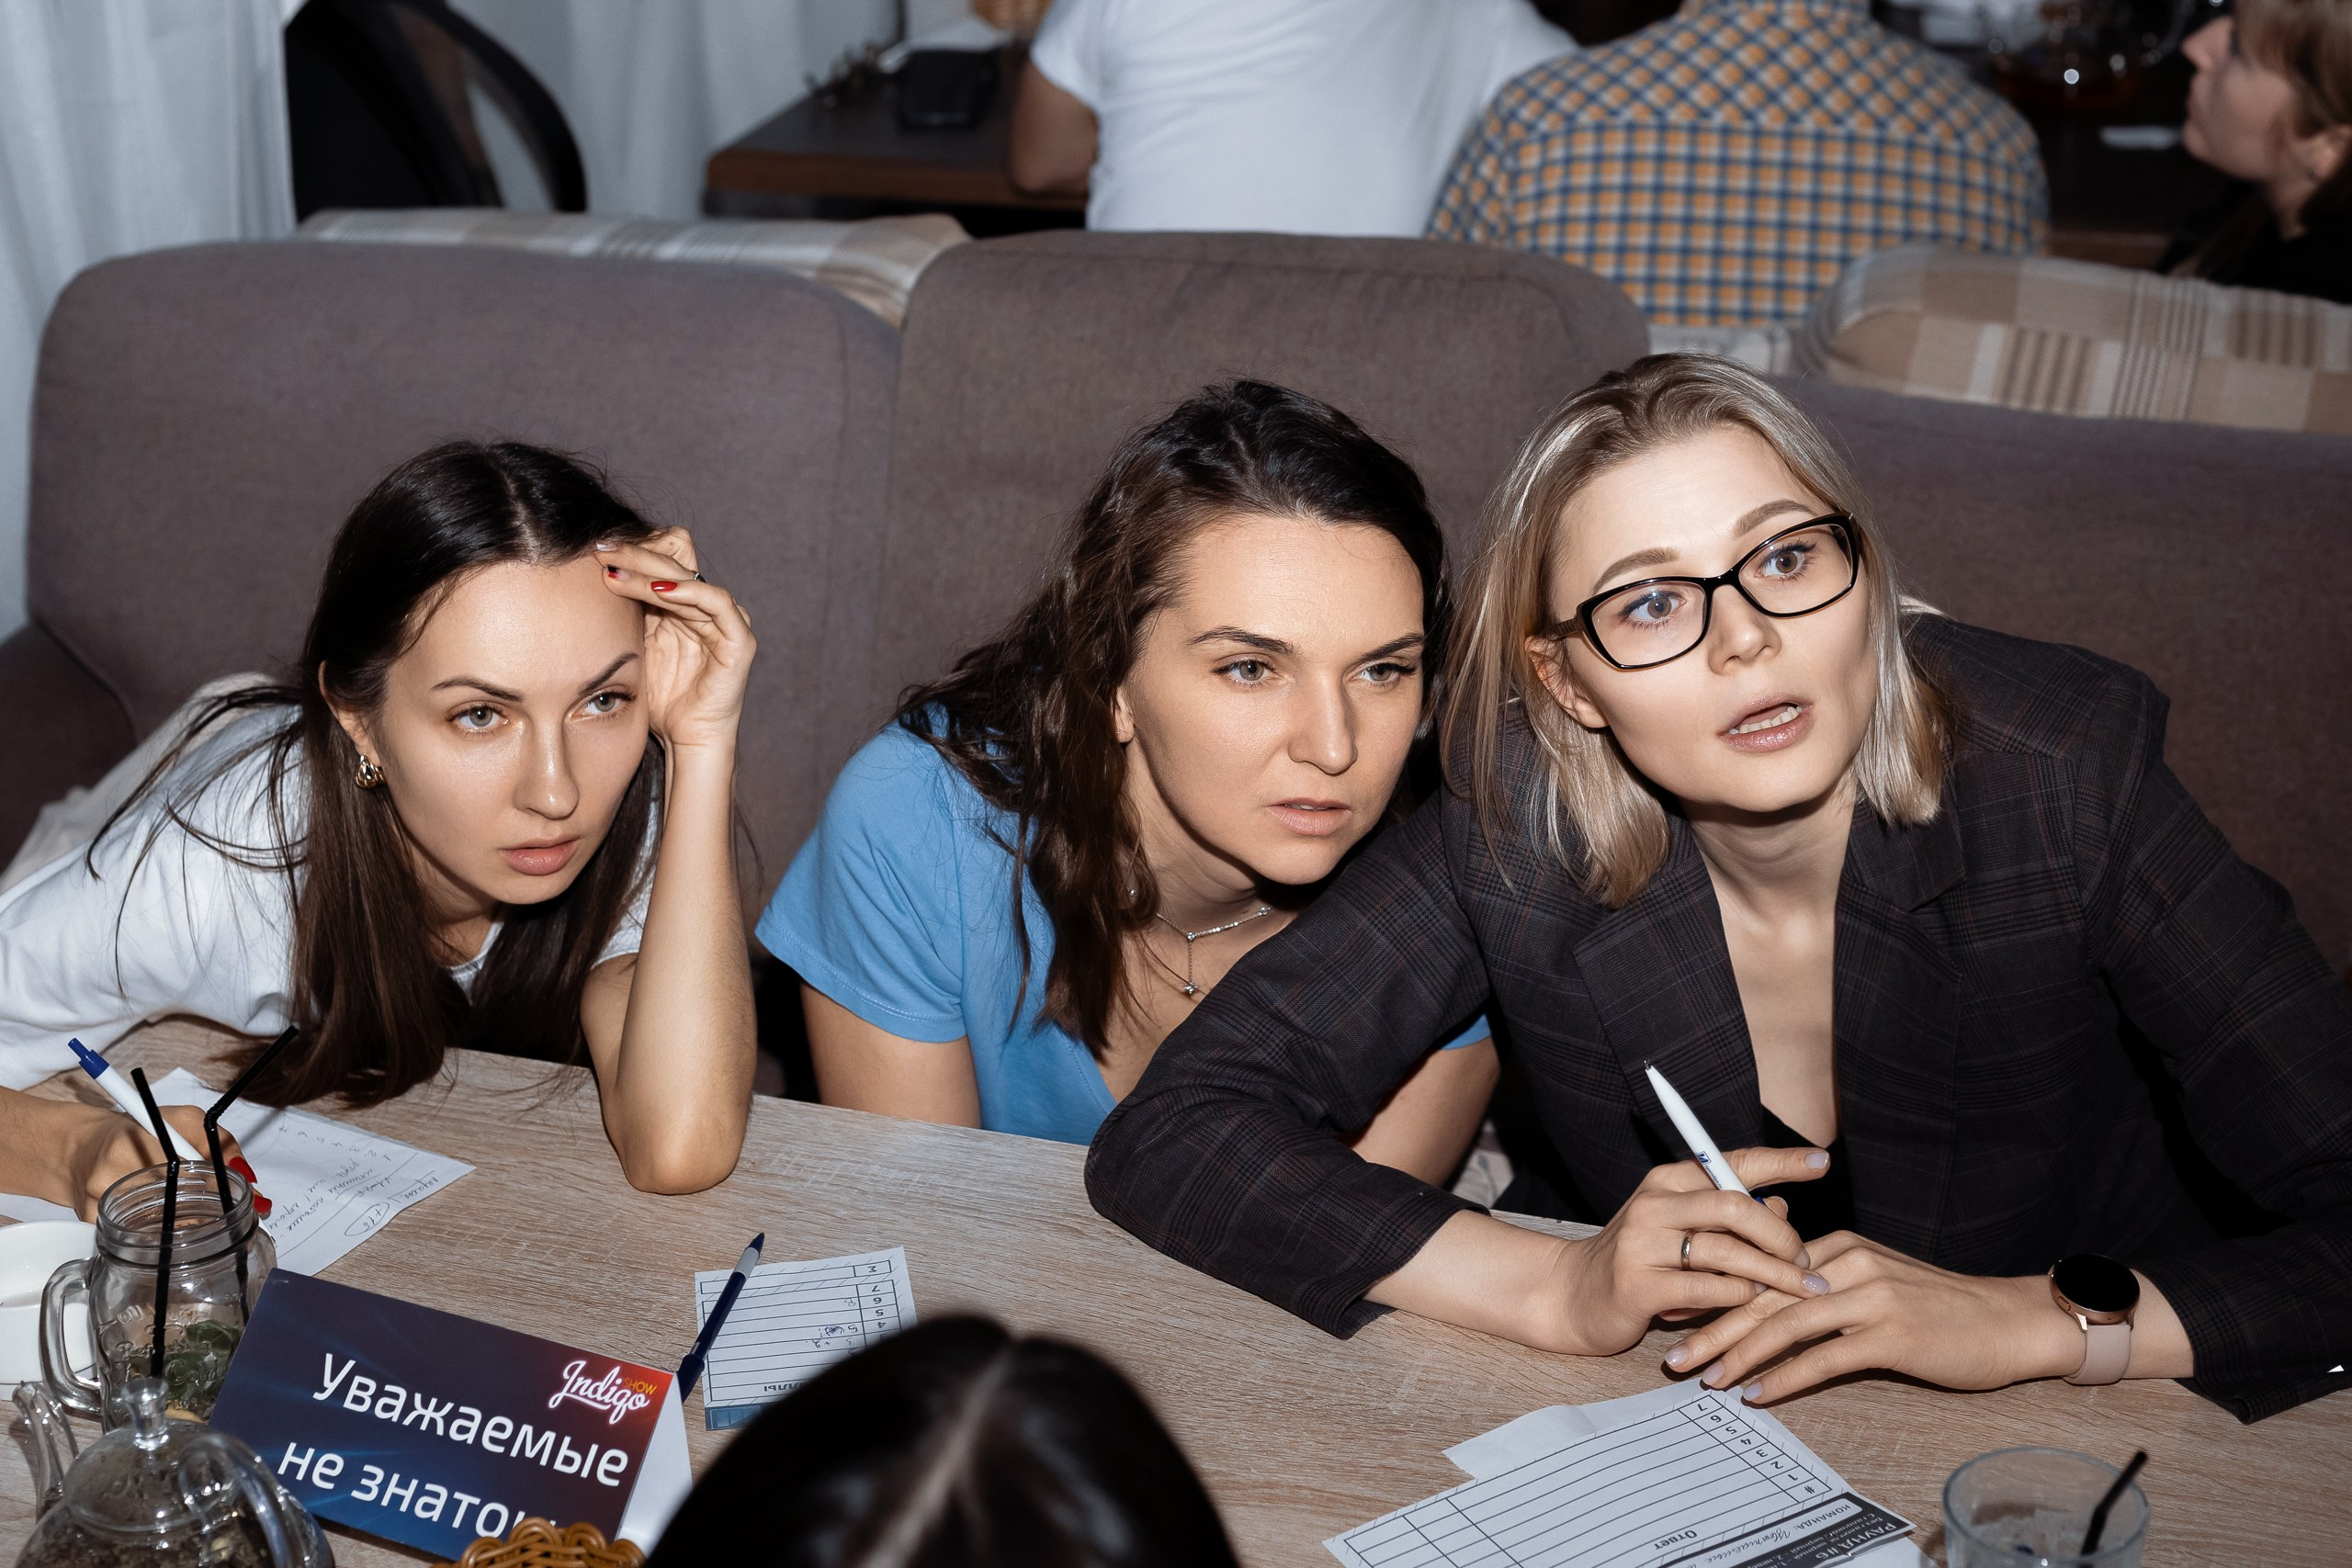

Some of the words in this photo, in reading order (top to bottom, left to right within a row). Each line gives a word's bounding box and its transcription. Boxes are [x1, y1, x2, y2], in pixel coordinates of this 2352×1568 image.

[548, 1359, 650, 1426] Indigo
[625, 1377, 658, 1395] SHOW
[1697, 1404, 1708, 1412] 7
[313, 1352, 628, 1488] Уважаемые
[1710, 1415, 1723, 1423] 6
[1724, 1426, 1737, 1435] 5
[1740, 1438, 1752, 1446] 4
[1755, 1449, 1769, 1458] 3
[1770, 1461, 1784, 1470] 2
[277, 1442, 345, 1491] не
[350, 1466, 557, 1539] знато
[1794, 1504, 1851, 1531] КОМАНДА:
[1654, 1529, 1698, 1551] Ответ
